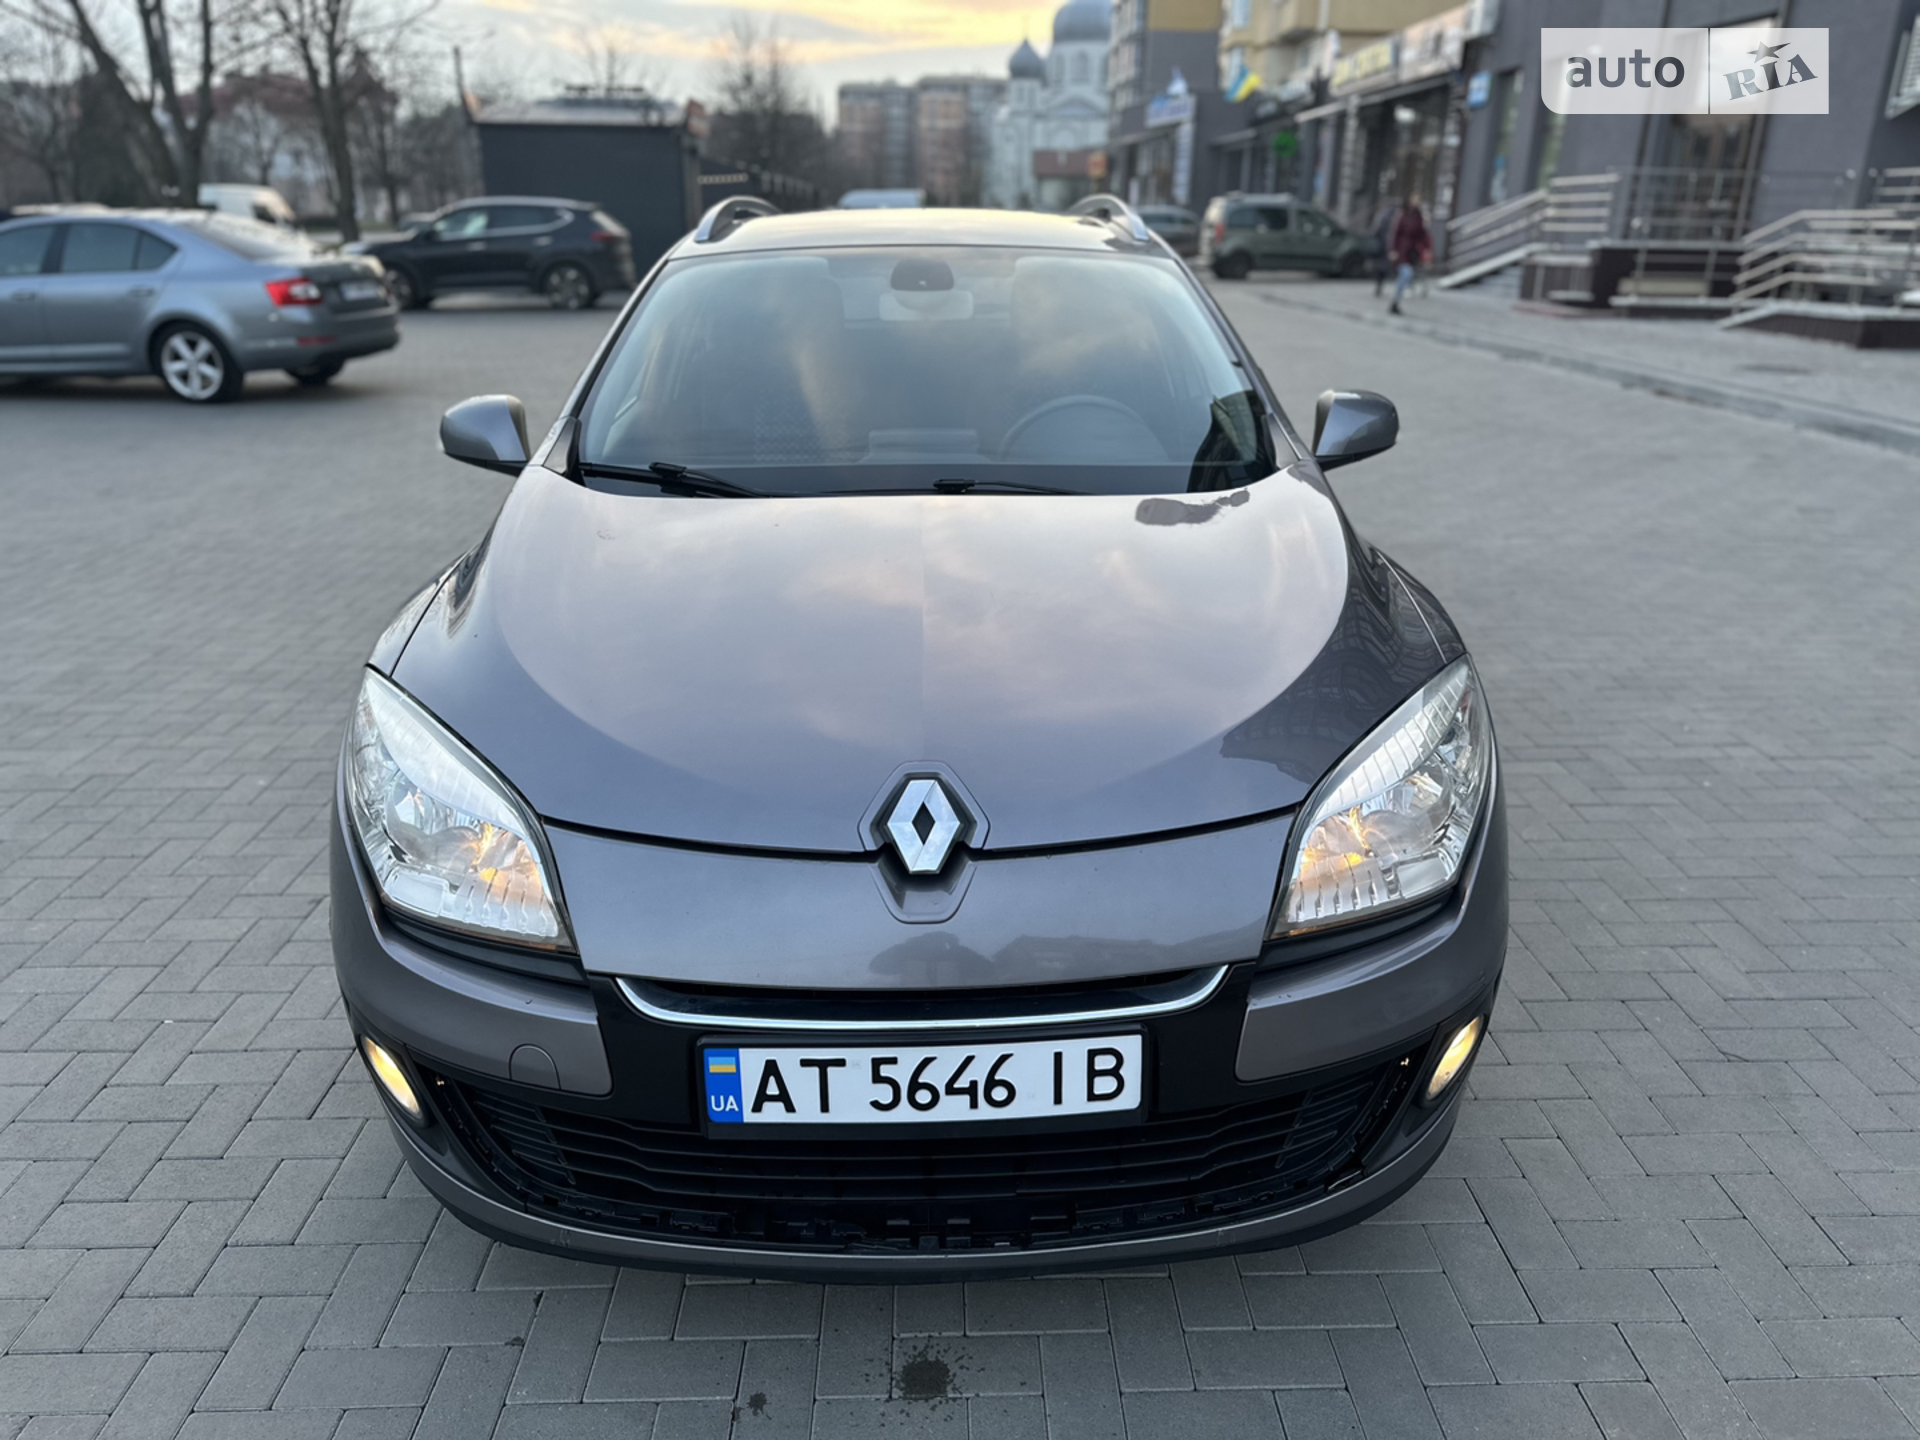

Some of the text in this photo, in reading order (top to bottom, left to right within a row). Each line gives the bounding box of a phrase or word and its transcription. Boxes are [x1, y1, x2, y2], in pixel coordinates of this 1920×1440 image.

[751, 1047, 1125, 1113] AT 5646 IB
[711, 1095, 739, 1112] UA
